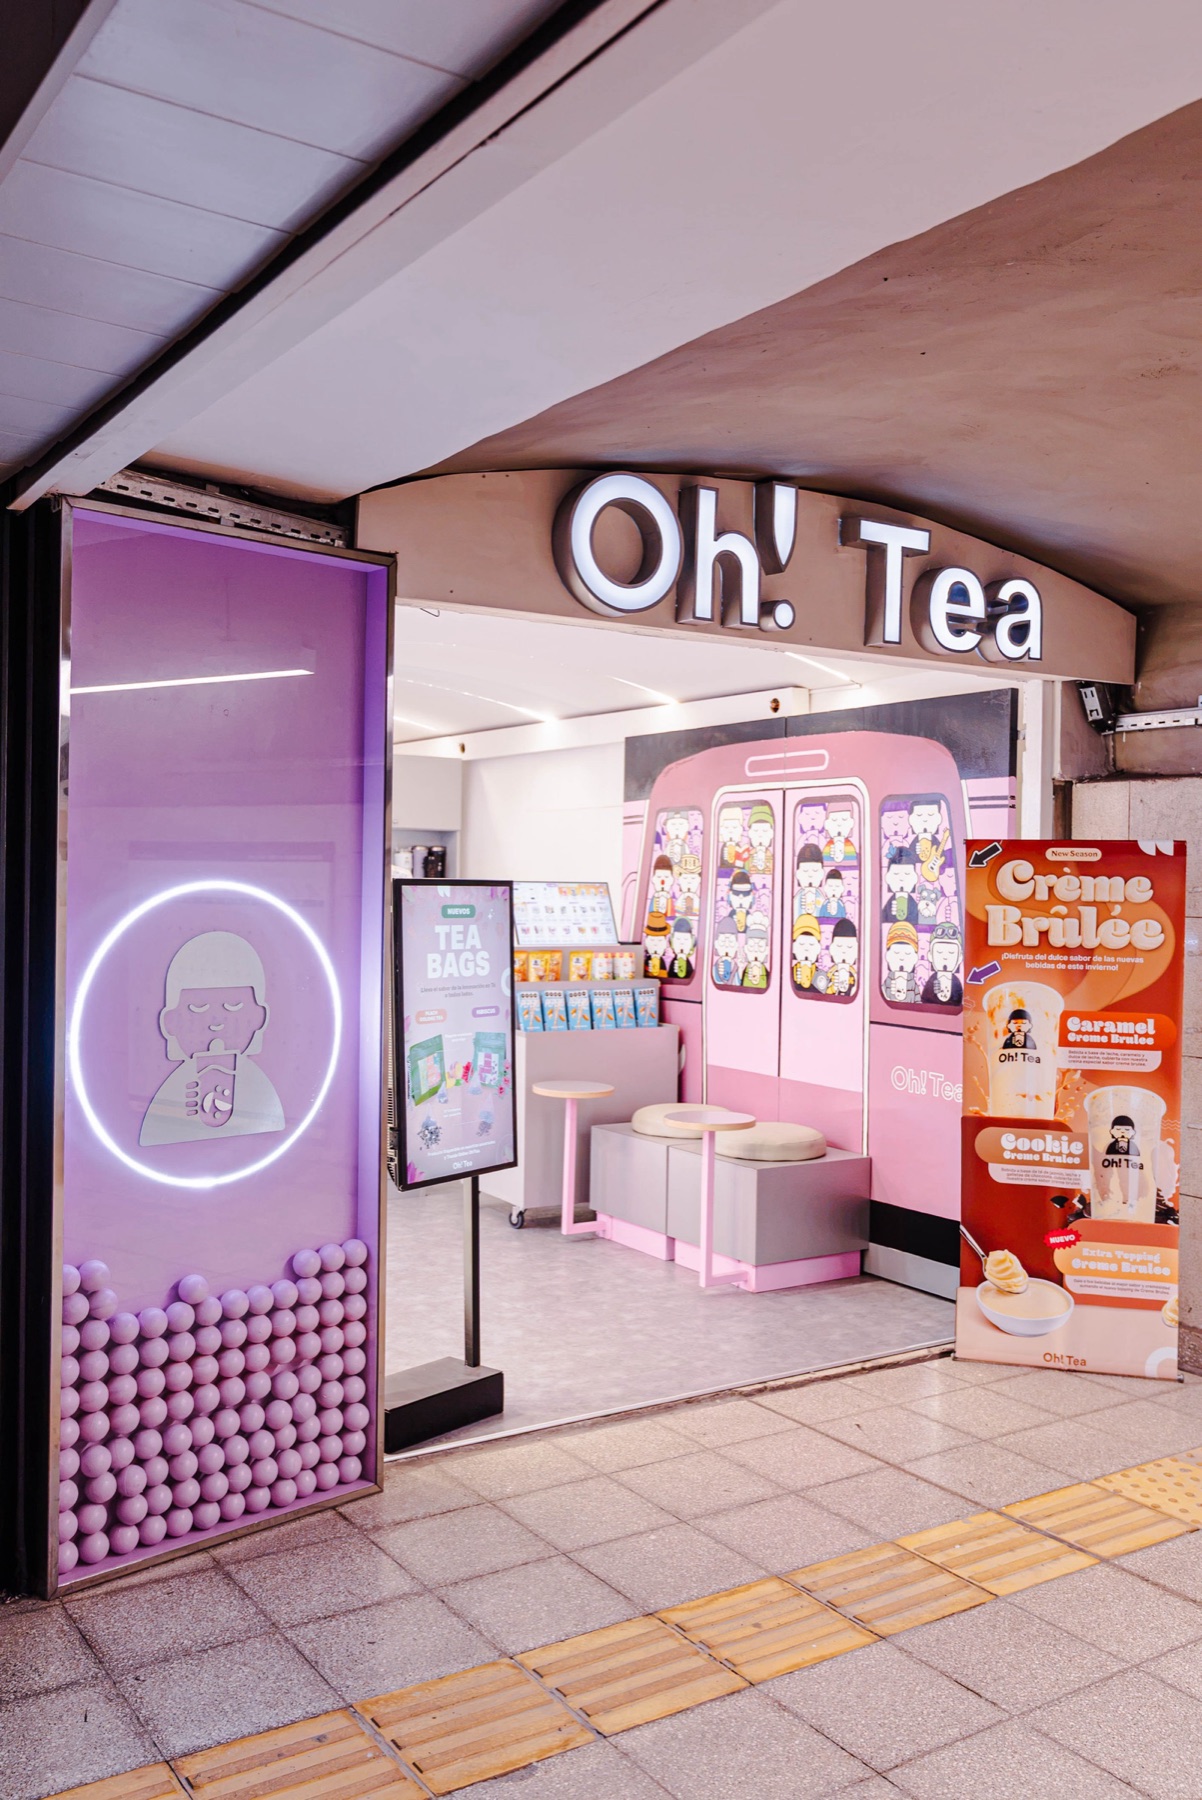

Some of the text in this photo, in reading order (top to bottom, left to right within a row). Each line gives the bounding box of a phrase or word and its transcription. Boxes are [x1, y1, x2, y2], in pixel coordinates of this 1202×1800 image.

[570, 473, 1043, 661] Oh! Tea
[996, 859, 1154, 903] Crème
[985, 904, 1165, 951] Brûlée
[434, 924, 482, 950] TEA
[427, 951, 490, 979] BAGS
[1085, 963, 1118, 971] invierno!
[1066, 1016, 1156, 1035] Caramel
[1067, 1032, 1154, 1045] Creme Brulee
[998, 1052, 1041, 1064] Oh! Tea
[891, 1066, 962, 1102] Oh! Tea
[1000, 1133, 1084, 1155] Cookie
[1003, 1150, 1081, 1165] Creme Brulee
[1102, 1158, 1144, 1170] Oh! Tea
[1049, 1234, 1076, 1244] NUEVO
[1082, 1248, 1160, 1264] Extra Topping
[1072, 1258, 1171, 1276] Creme Brulee
[1043, 1352, 1086, 1367] Oh! Tea
